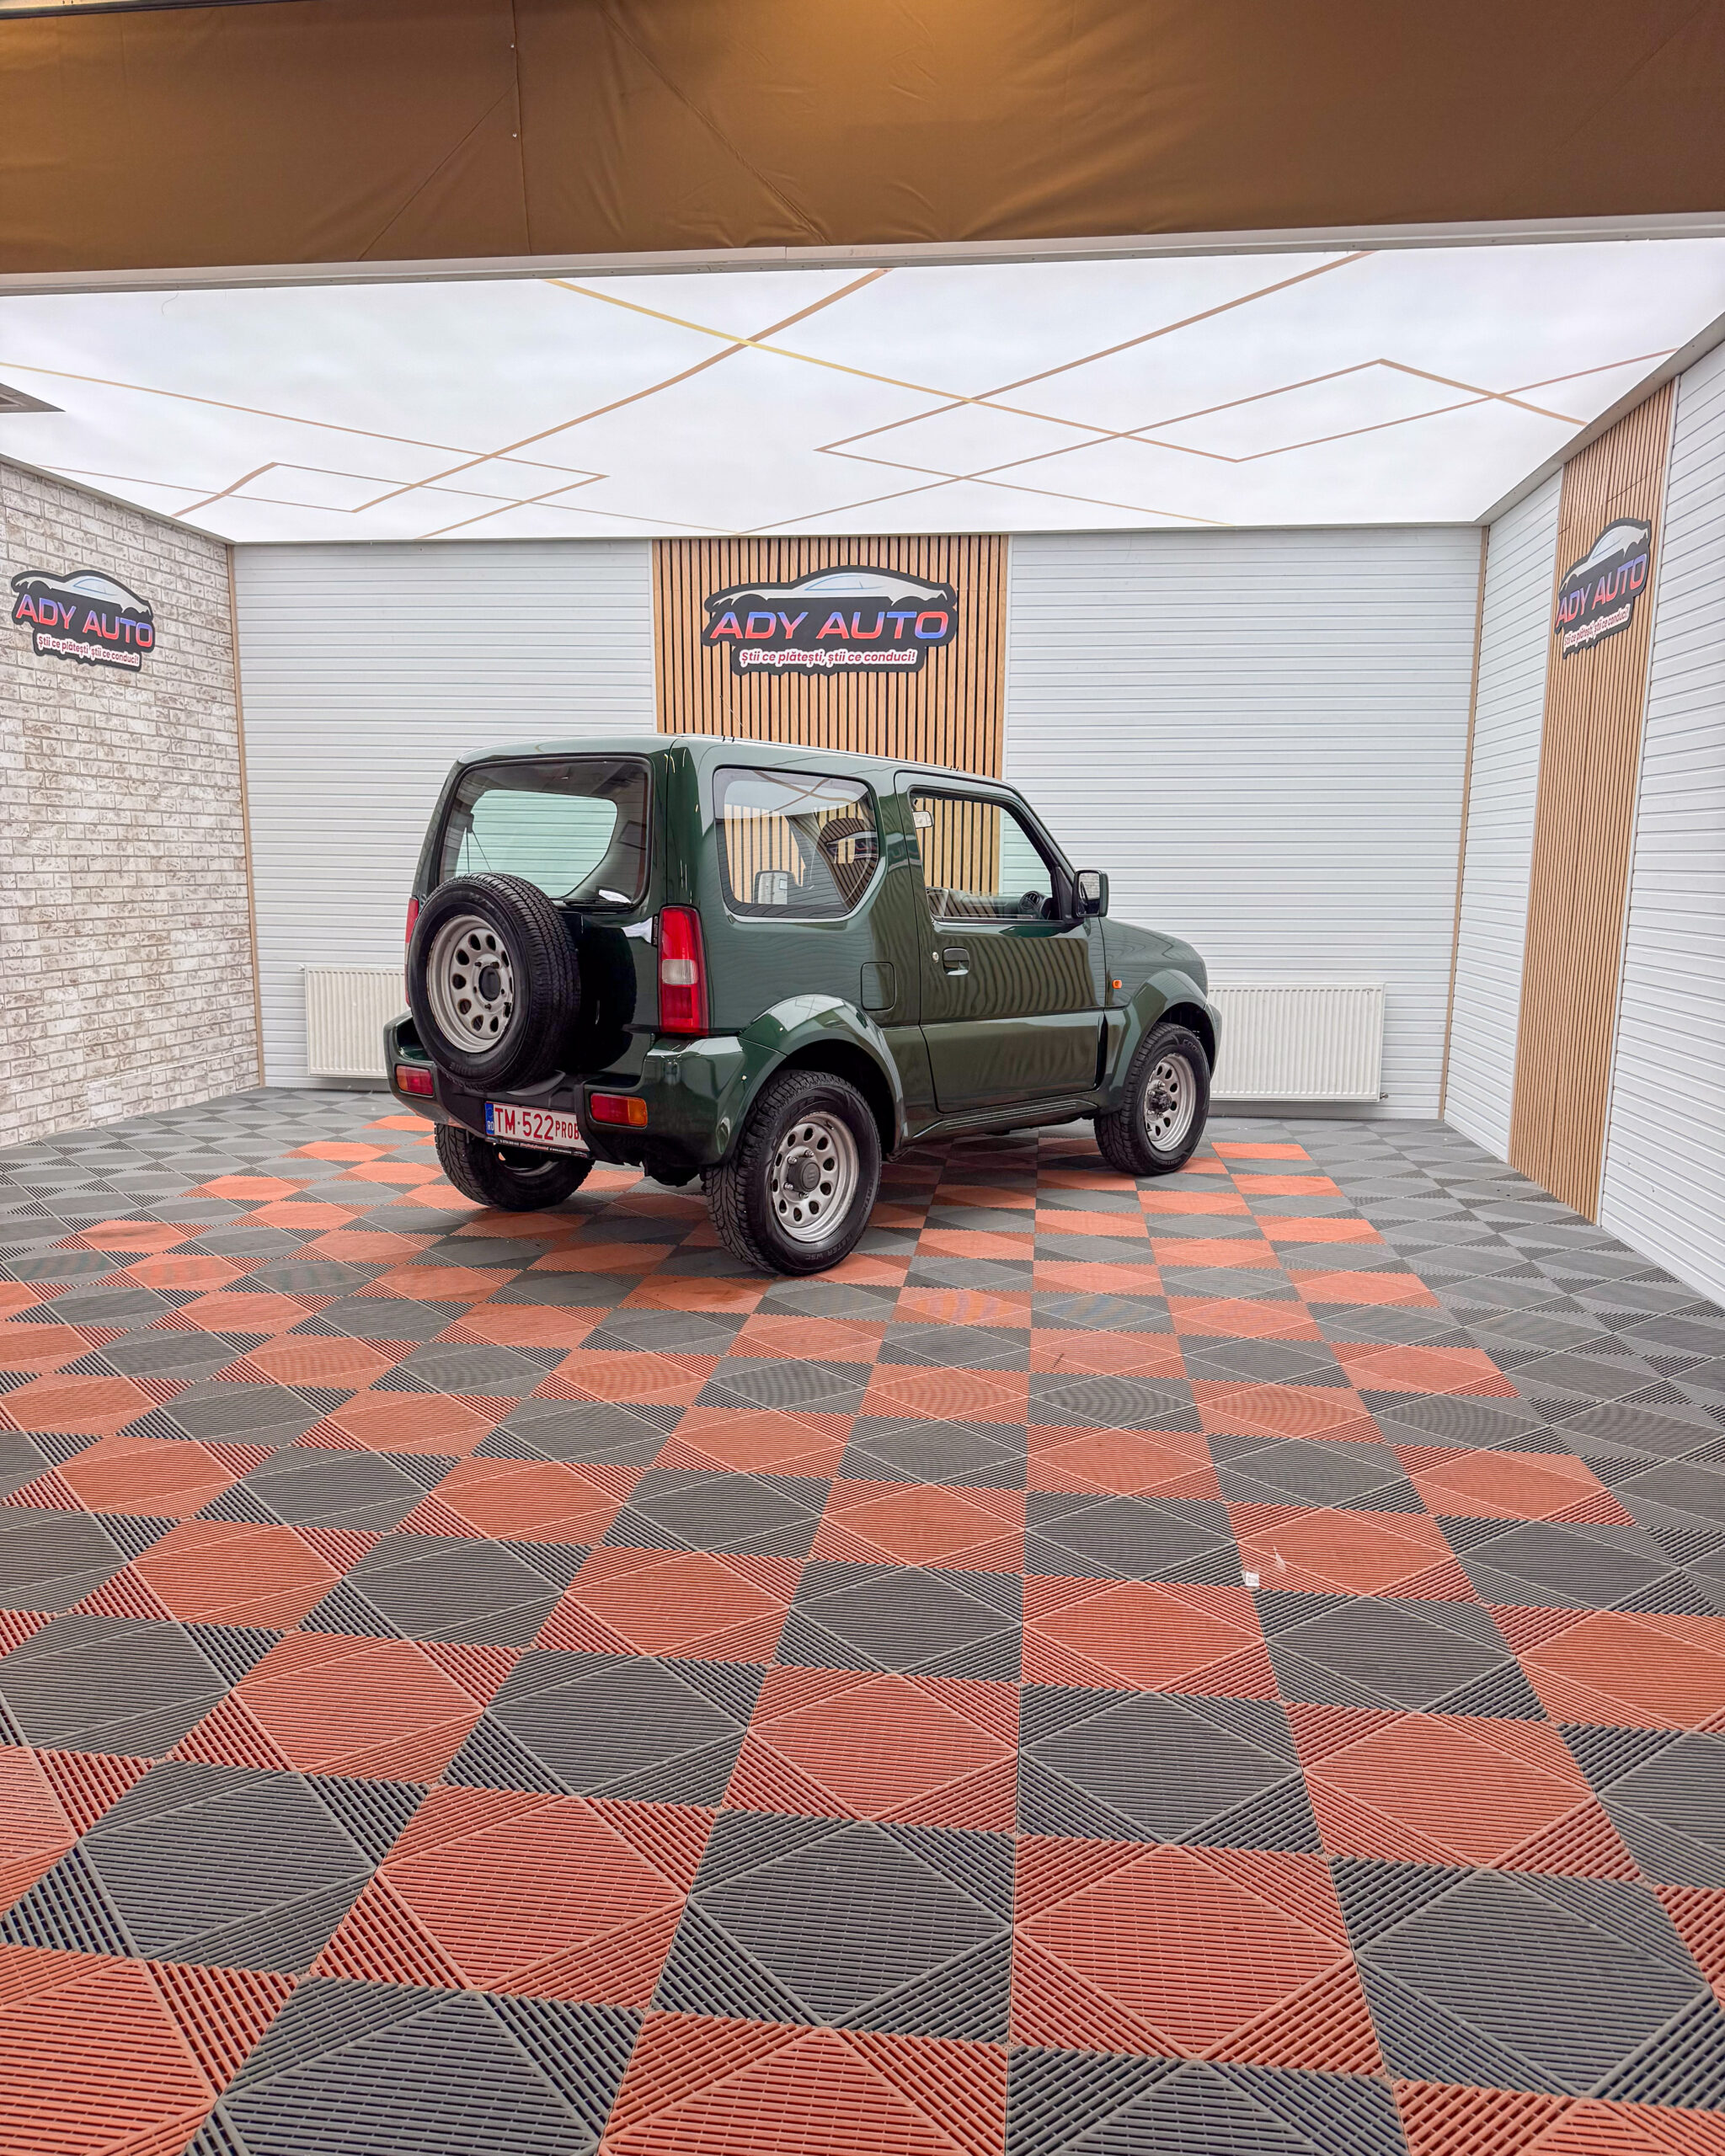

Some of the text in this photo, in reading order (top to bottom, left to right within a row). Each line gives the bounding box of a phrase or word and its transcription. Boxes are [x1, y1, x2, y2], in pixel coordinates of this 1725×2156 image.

[1556, 553, 1648, 628] ADY AUTO
[15, 594, 153, 648] ADY AUTO
[709, 611, 949, 639] ADY AUTO
[38, 635, 51, 648] Știi
[51, 640, 61, 648] ce
[102, 650, 111, 659] ce
[111, 652, 139, 664] conduci!
[741, 651, 916, 664] Știi ce plătești, știi ce conduci!
[487, 1120, 494, 1131] RO
[555, 1120, 584, 1140] PROB
